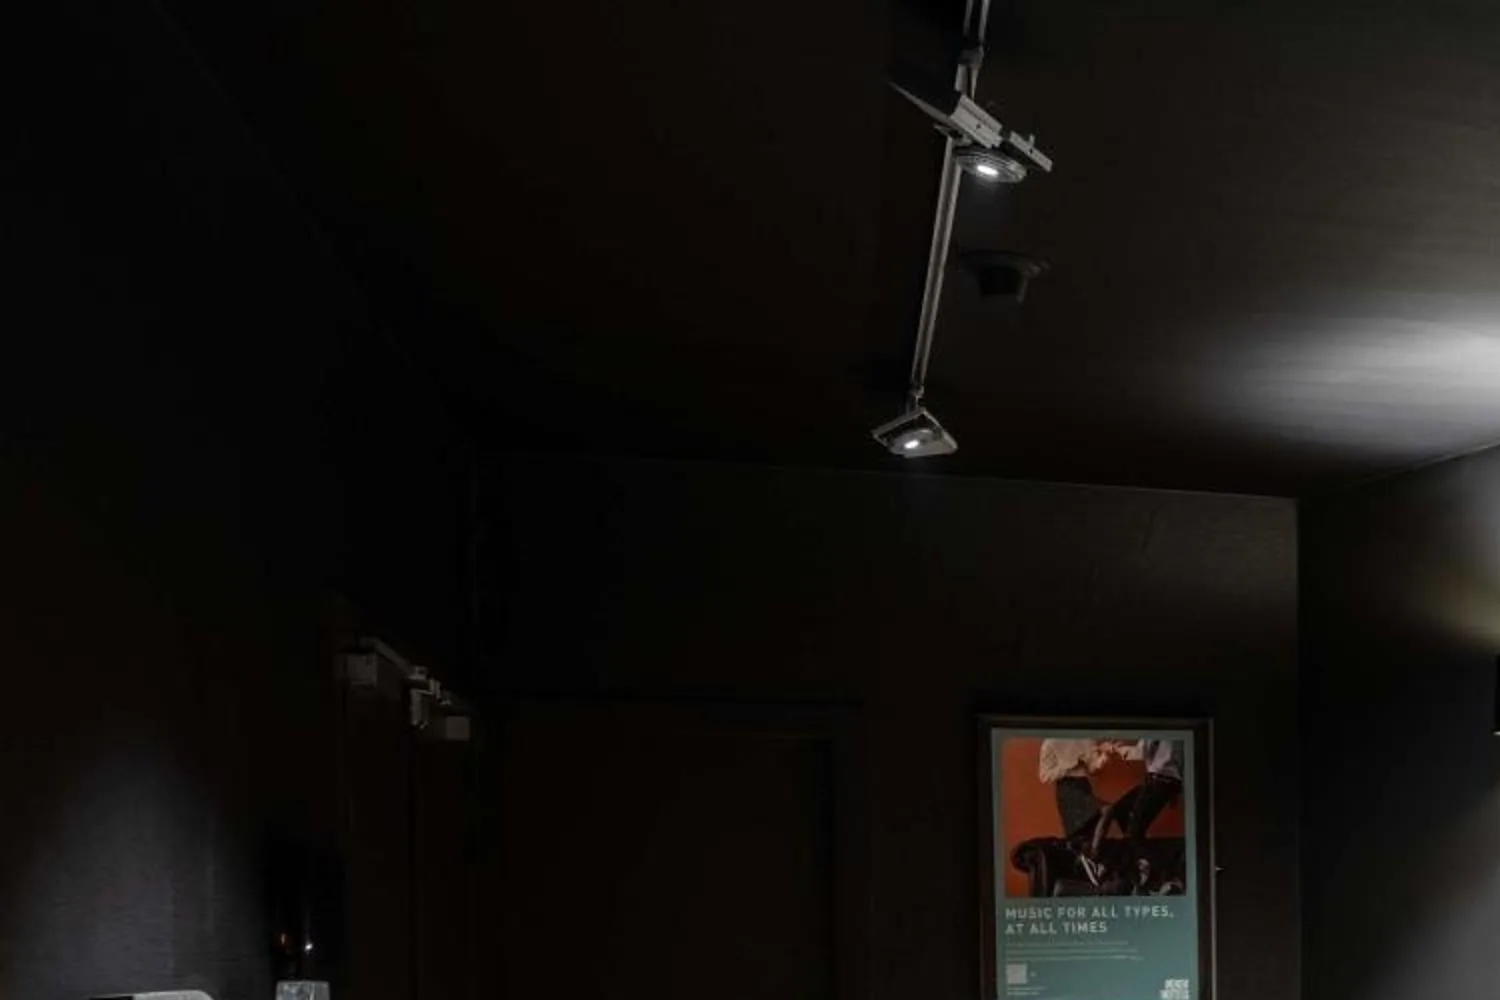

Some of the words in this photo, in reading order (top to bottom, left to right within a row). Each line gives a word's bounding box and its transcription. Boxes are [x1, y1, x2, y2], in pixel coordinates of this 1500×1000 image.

[1005, 907, 1052, 920] MUSIC
[1057, 906, 1086, 918] FOR
[1091, 906, 1119, 918] ALL
[1005, 923, 1025, 935] AT
[1029, 922, 1057, 935] ALL
[1064, 921, 1108, 933] TIMES
